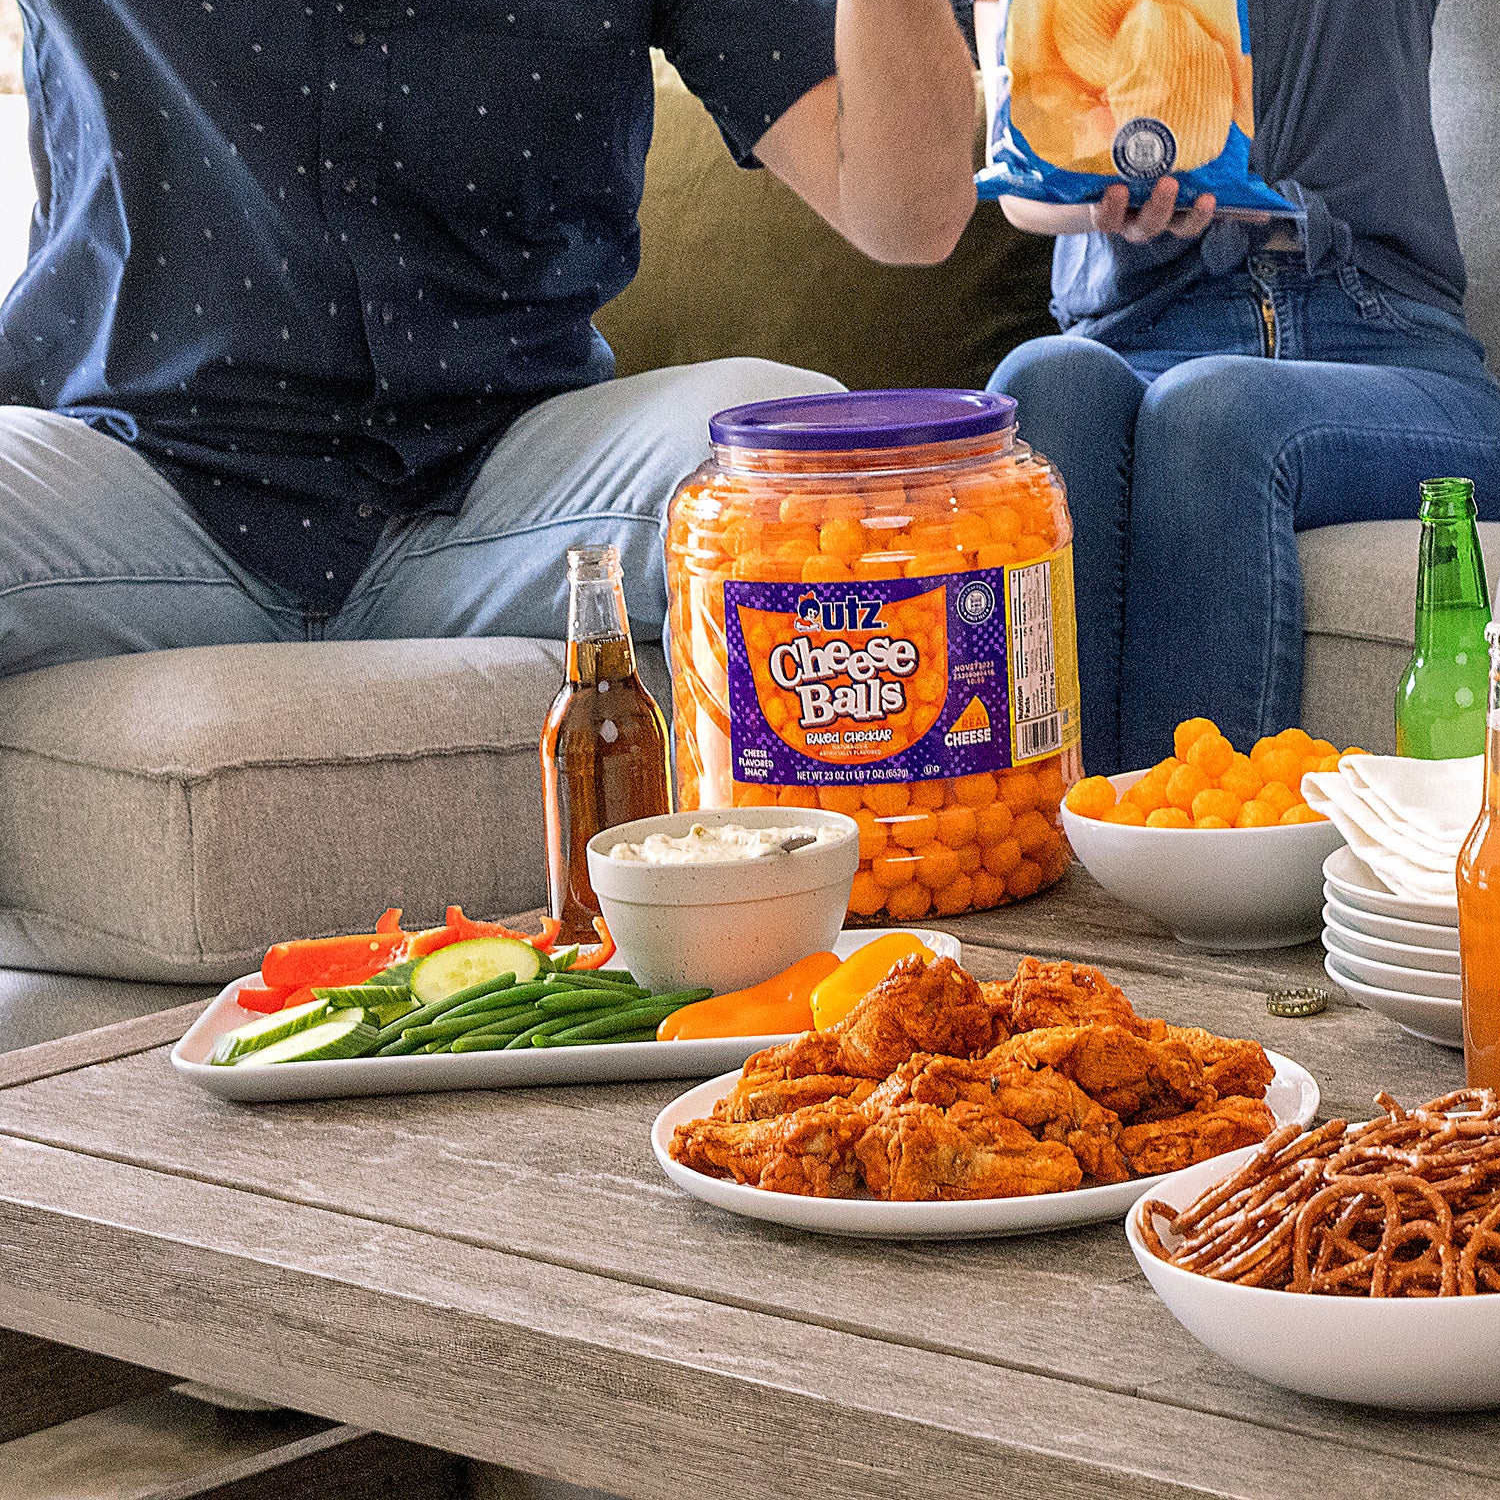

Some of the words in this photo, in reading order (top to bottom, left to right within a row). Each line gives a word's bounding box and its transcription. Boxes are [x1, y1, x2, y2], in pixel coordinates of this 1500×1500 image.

[820, 595, 883, 632] utz
[769, 636, 918, 690] Cheese
[795, 678, 905, 728] Balls
[944, 727, 992, 747] CHEESE
[743, 749, 768, 758] CHEESE
[738, 757, 774, 770] FLAVORED
[744, 768, 768, 778] SNACK
[796, 770, 811, 781] NET
[812, 771, 823, 781] WT
[824, 771, 834, 780] 23
[834, 770, 845, 780] OZ
[865, 770, 871, 779] 7
